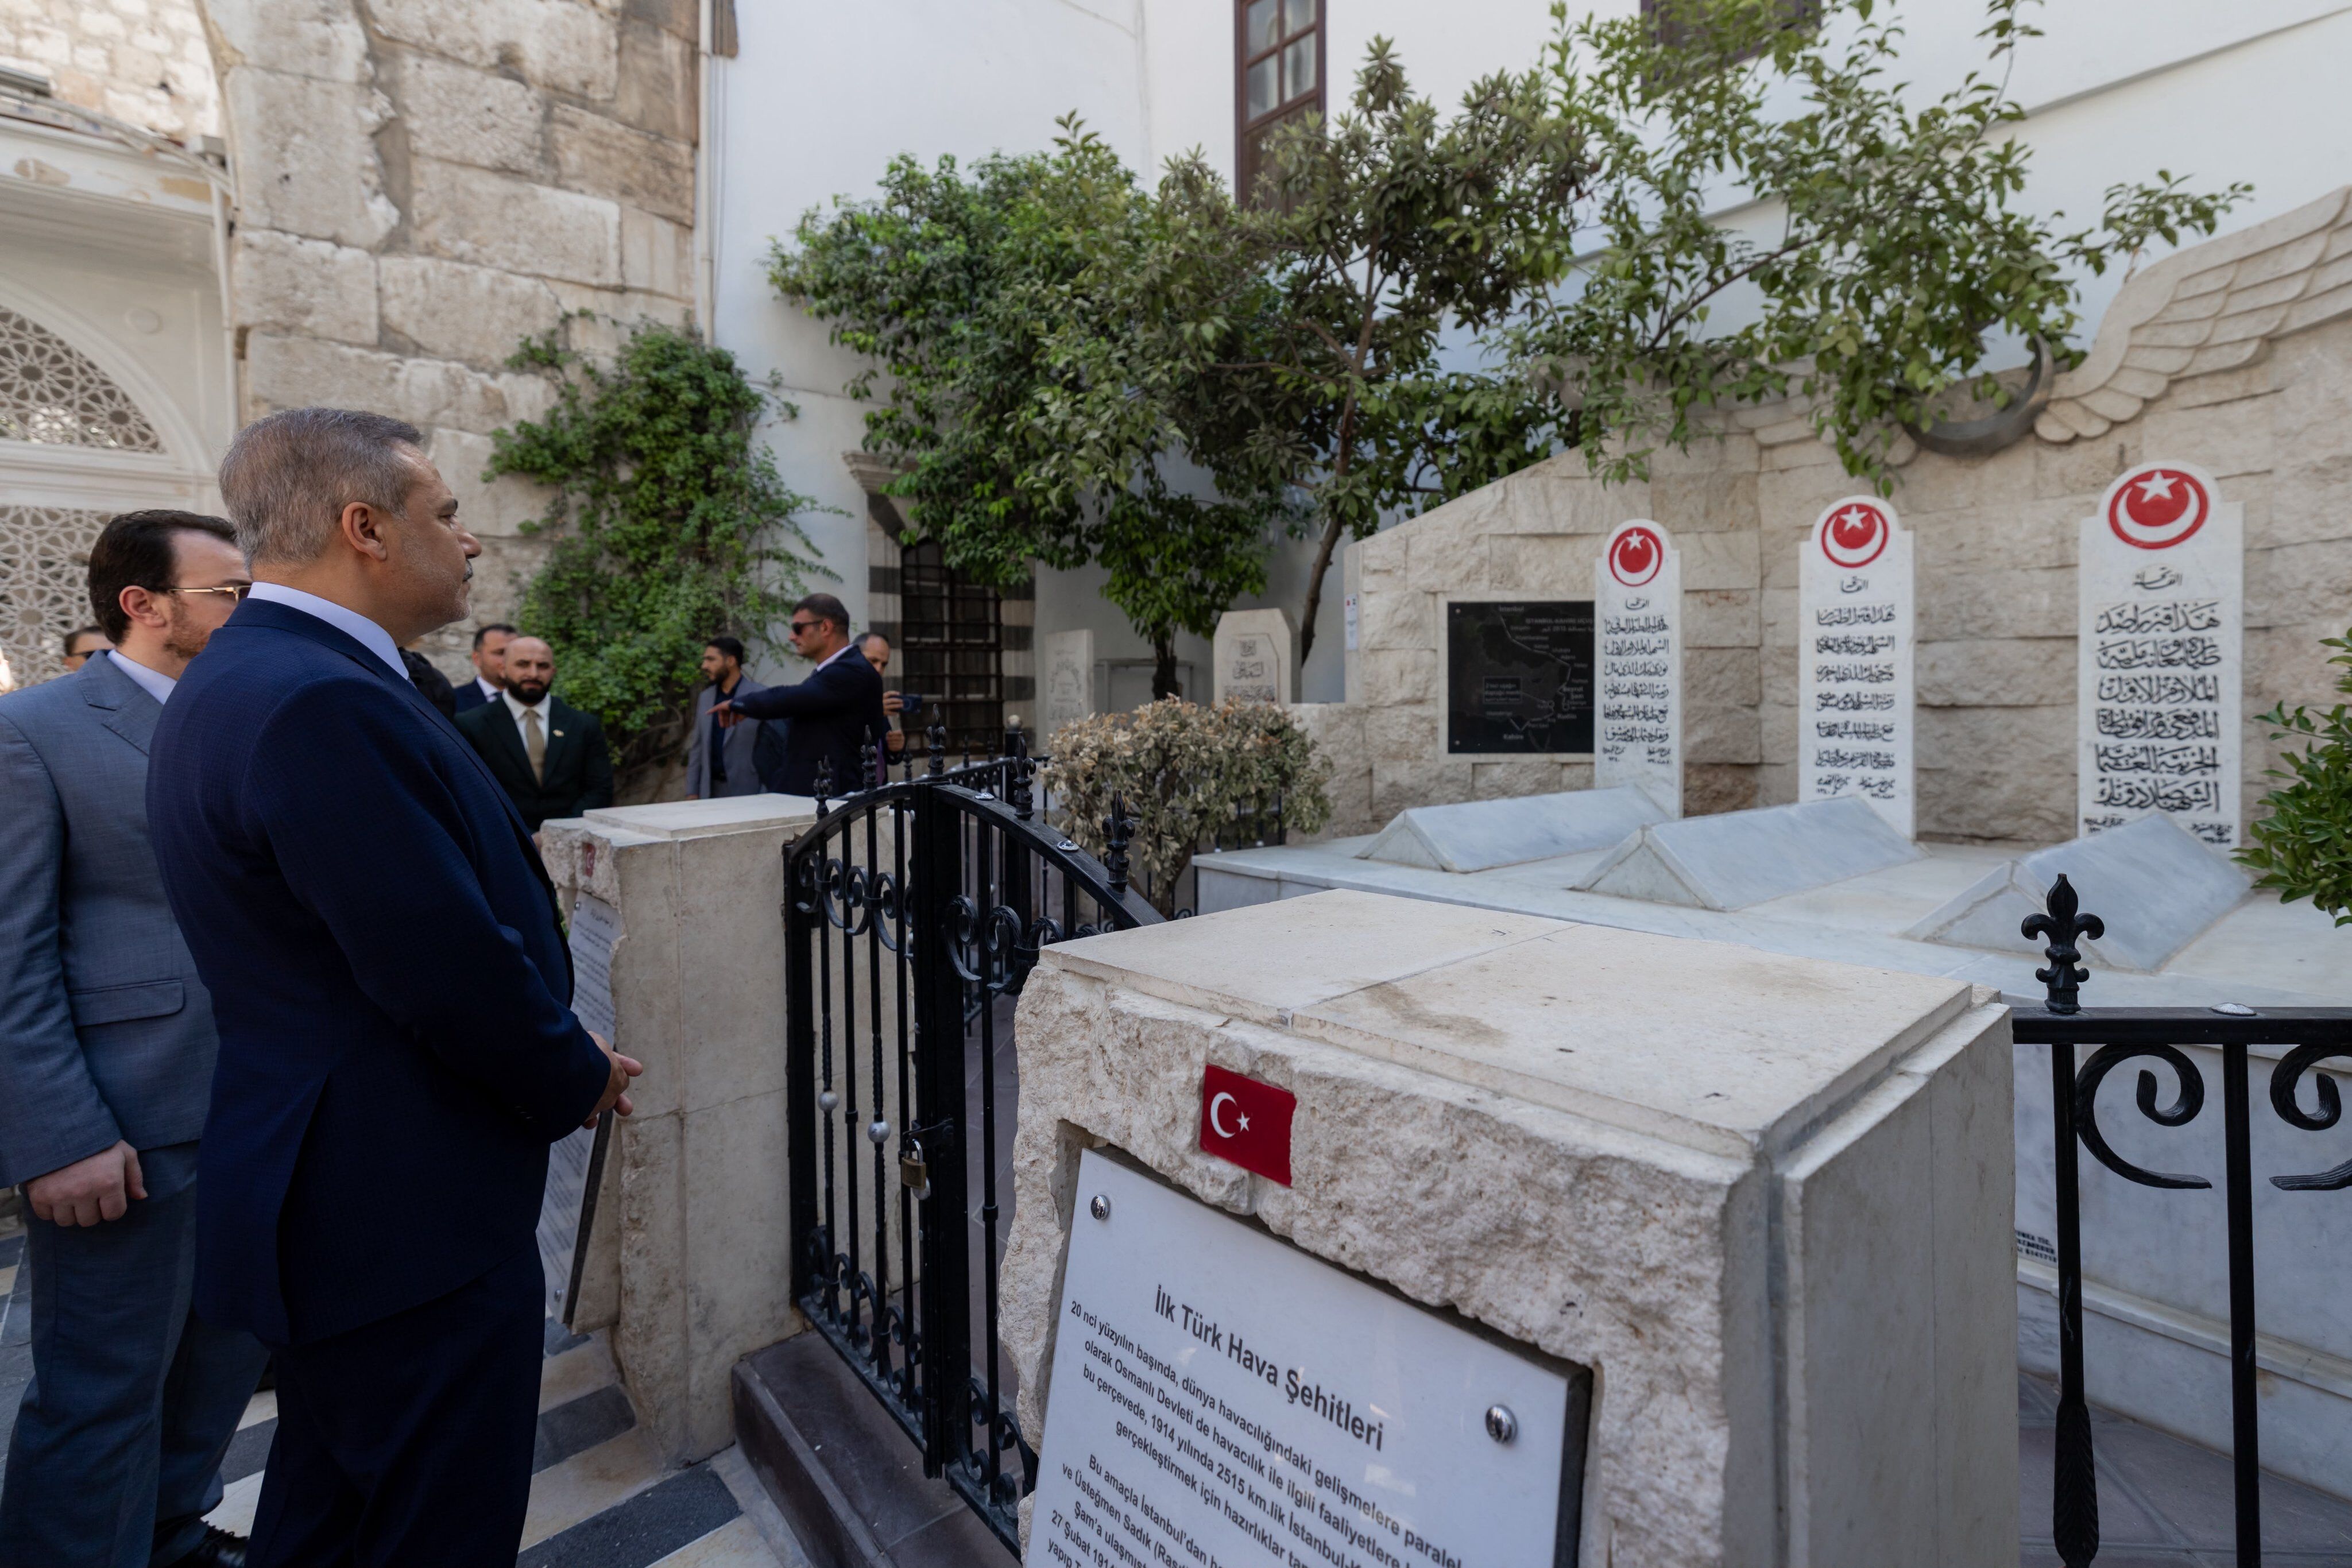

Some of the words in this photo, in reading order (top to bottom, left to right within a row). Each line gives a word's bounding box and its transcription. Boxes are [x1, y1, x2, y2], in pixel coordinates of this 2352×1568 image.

[1071, 1301, 1081, 1317] 20
[1084, 1311, 1097, 1329] nci
[1098, 1322, 1134, 1354] yüzyılın
[1136, 1344, 1178, 1389] başında,
[1182, 1377, 1215, 1410] dünya
[1219, 1399, 1312, 1477] havacılığındaki
[1315, 1469, 1399, 1536] gelişmelere
[1155, 1284, 1175, 1323] İlk
[1182, 1304, 1222, 1352] Türk
[1228, 1333, 1278, 1387] Hava
[1285, 1369, 1383, 1451] Şehitleri
[1063, 1464, 1072, 1480] ve
[1074, 1469, 1120, 1524] Üsteğmen
[1124, 1515, 1151, 1550] Sadık
[1084, 1364, 1095, 1383] bu
[1097, 1377, 1148, 1425] çerçevede,
[1152, 1415, 1174, 1442] 1914
[1177, 1437, 1213, 1472] yılında
[1217, 1463, 1245, 1495] 2515
[1248, 1485, 1285, 1526] km.lik
[1085, 1341, 1112, 1368] olarak
[1115, 1359, 1154, 1397] Osmanlı
[1157, 1387, 1193, 1425] Devleti
[1196, 1418, 1209, 1437] de
[1213, 1425, 1265, 1480] havacılık
[1268, 1466, 1283, 1489] ile
[1287, 1479, 1315, 1513] ilgili
[1320, 1501, 1400, 1568] faaliyetlere
[1089, 1454, 1102, 1476] Bu
[1104, 1471, 1138, 1507] amaçla
[1116, 1419, 1197, 1492] gerçekleştirmek
[1201, 1481, 1221, 1510] için
[1224, 1500, 1285, 1559] hazırlıklar
[1051, 1509, 1063, 1528] 27
[1065, 1521, 1090, 1557] Şubat
[1093, 1549, 1114, 1568] 191
